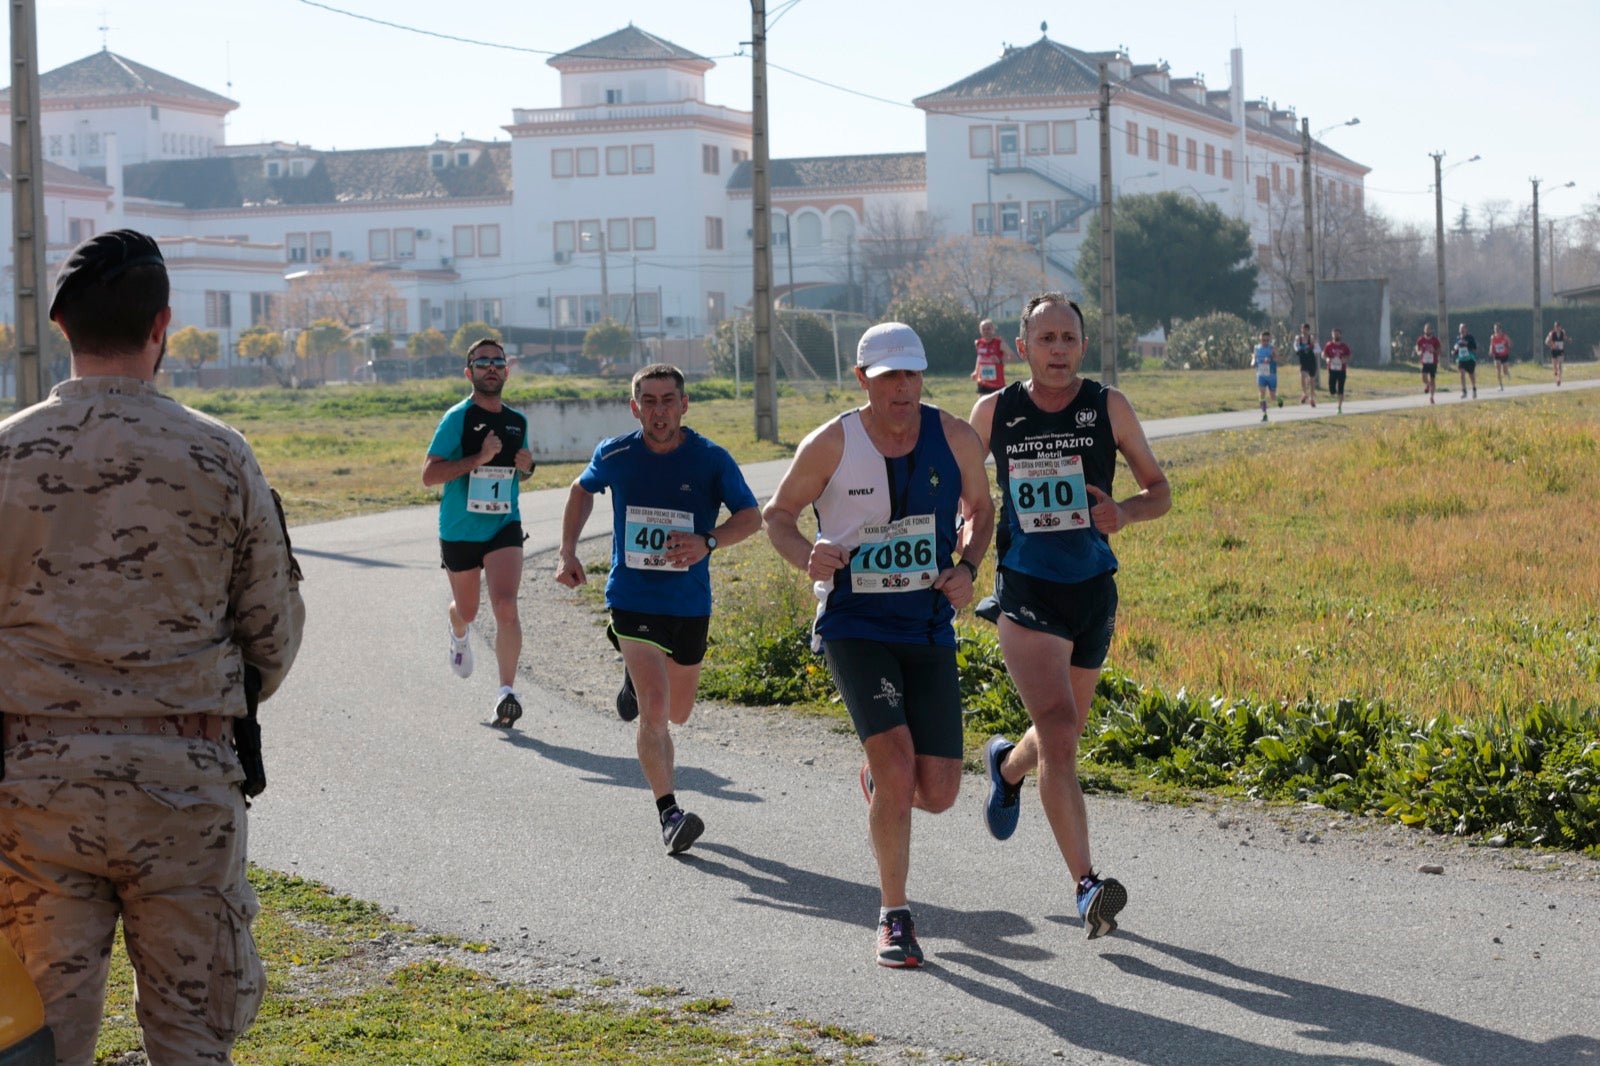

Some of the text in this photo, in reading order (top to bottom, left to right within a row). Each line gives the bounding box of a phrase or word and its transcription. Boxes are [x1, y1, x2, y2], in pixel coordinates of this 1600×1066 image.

[1006, 442, 1042, 454] PAZITO
[1056, 437, 1094, 449] PAZITO
[1037, 451, 1062, 459] Motril
[492, 482, 499, 499] 1
[848, 488, 874, 496] RIVELF
[1018, 480, 1073, 509] 810
